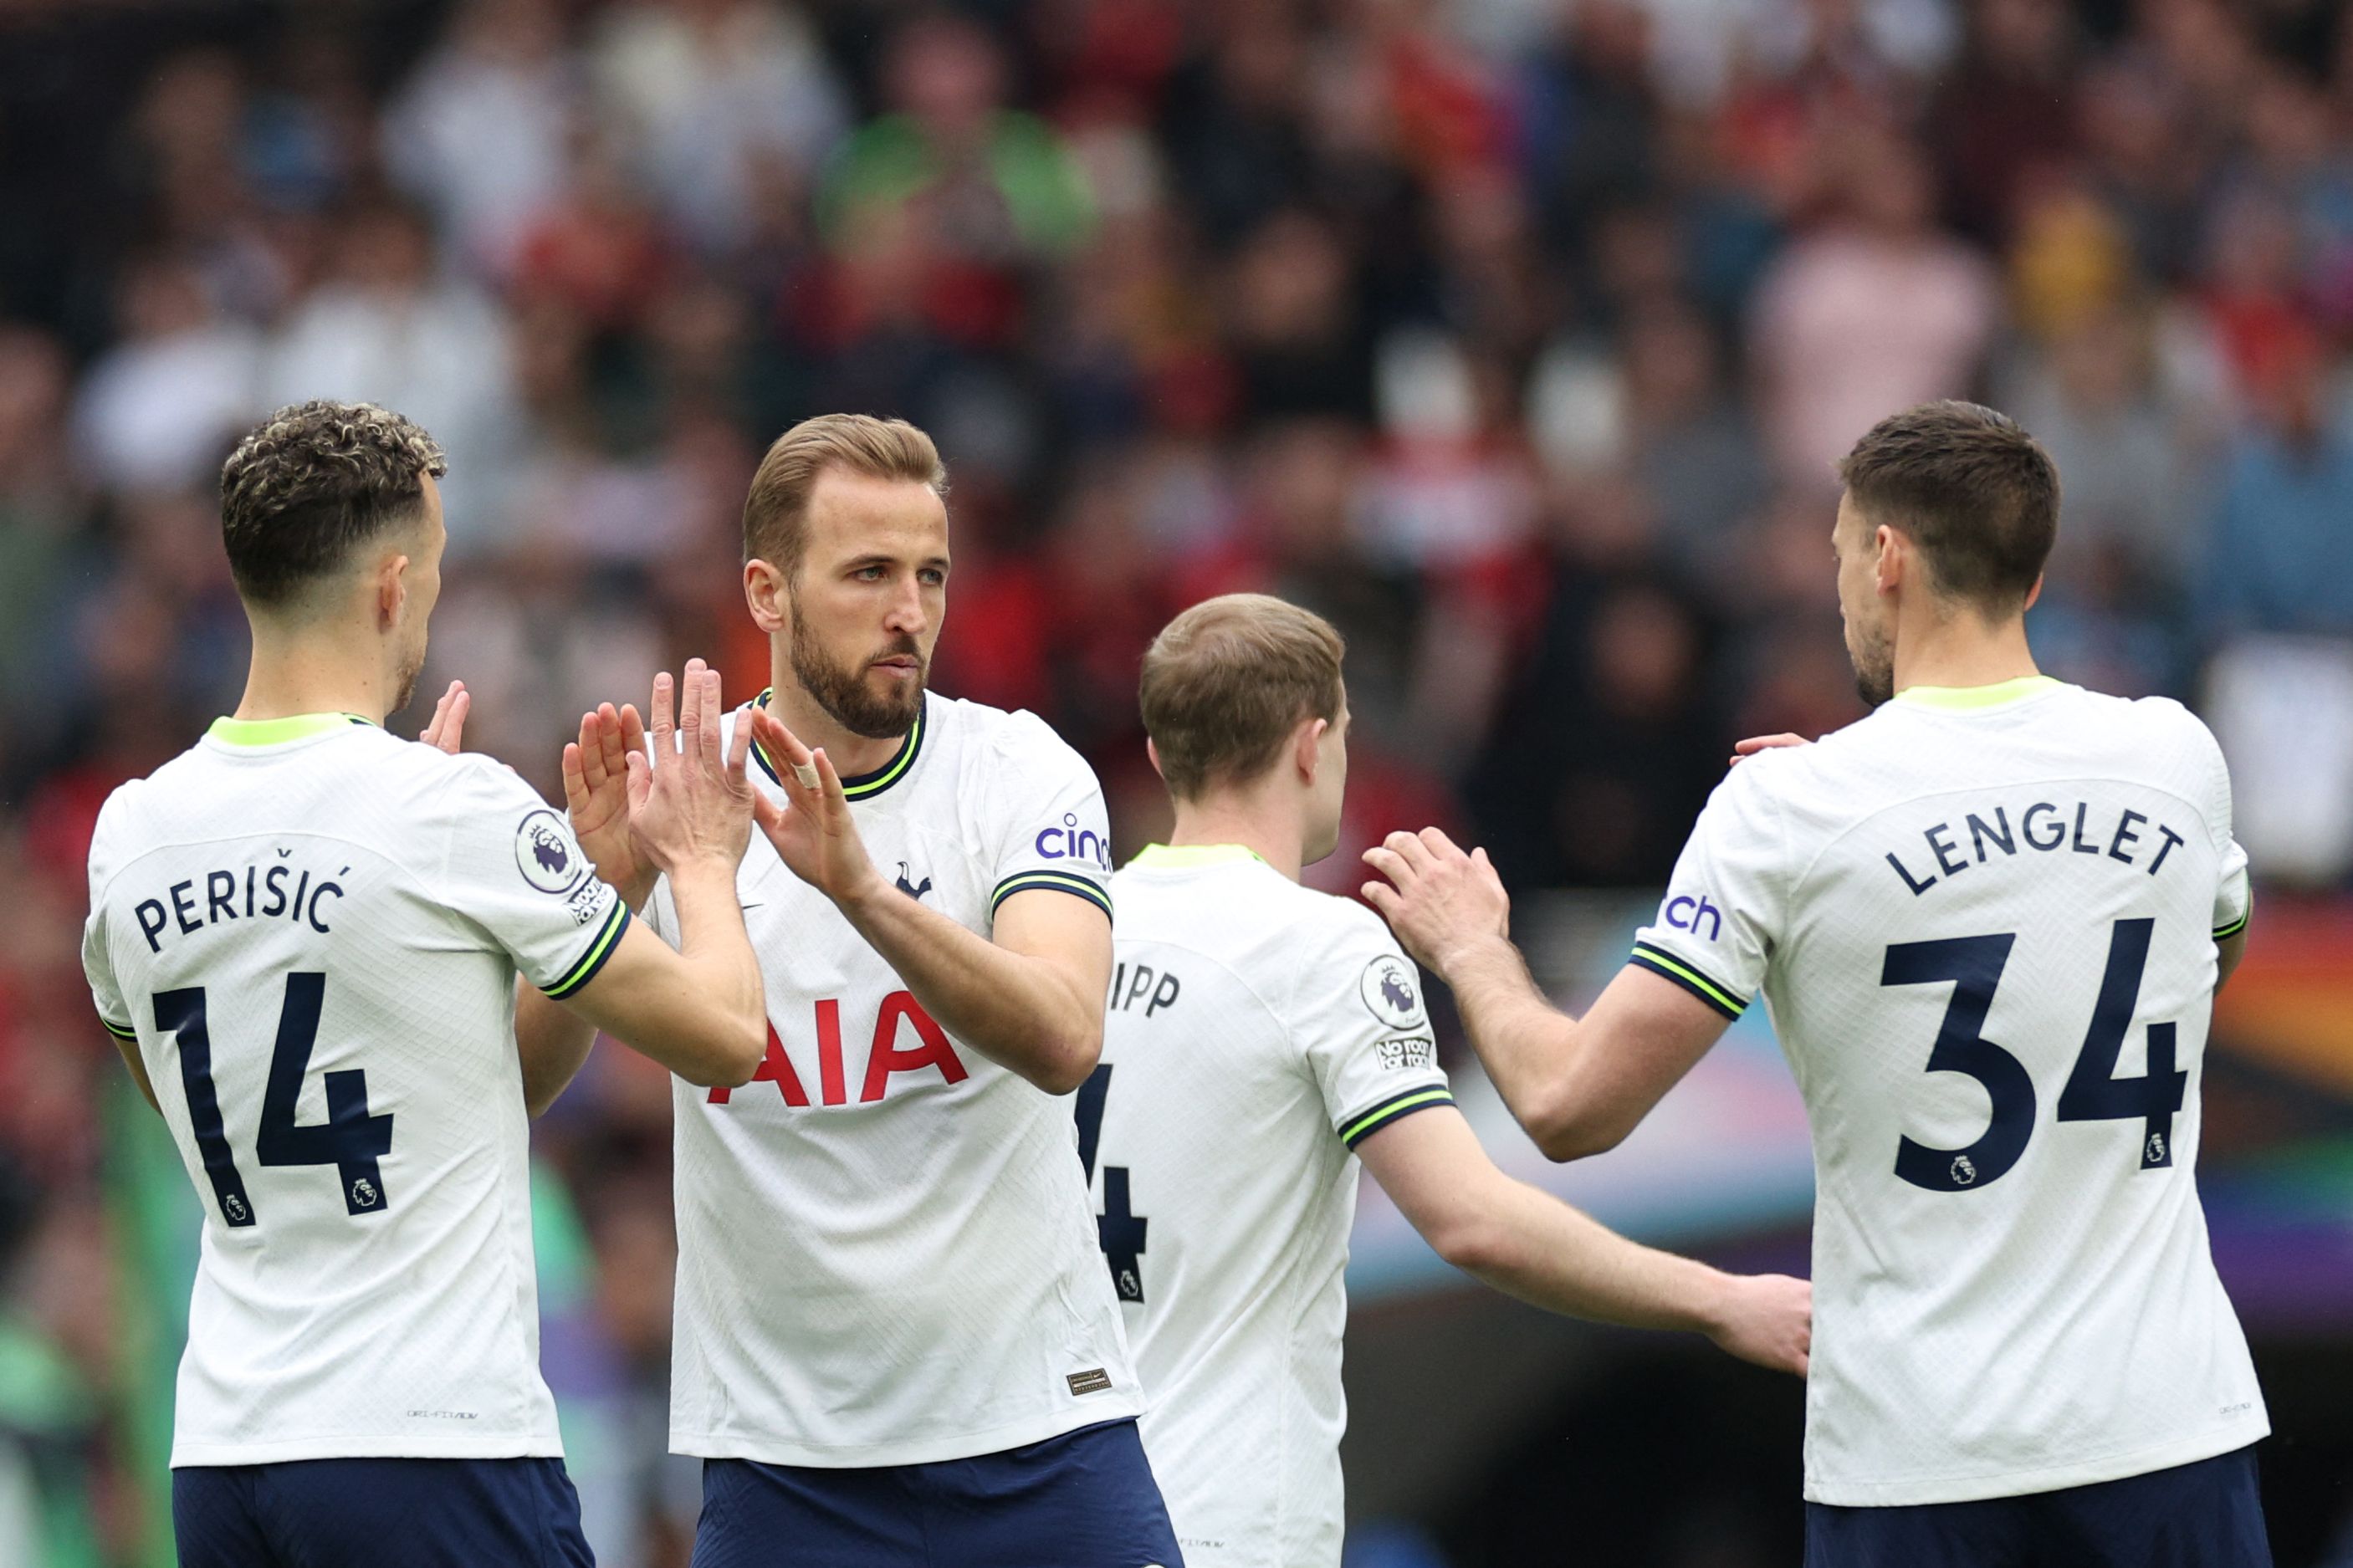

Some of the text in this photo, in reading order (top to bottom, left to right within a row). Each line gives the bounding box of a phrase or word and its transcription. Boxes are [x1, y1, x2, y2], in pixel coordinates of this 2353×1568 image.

[1886, 802, 2185, 896] LENGLET
[134, 848, 350, 953] PERIŠIĆ
[1664, 894, 1721, 942] ch
[1110, 962, 1180, 1019] IPP
[151, 972, 395, 1227] 14
[1880, 917, 2188, 1193] 34
